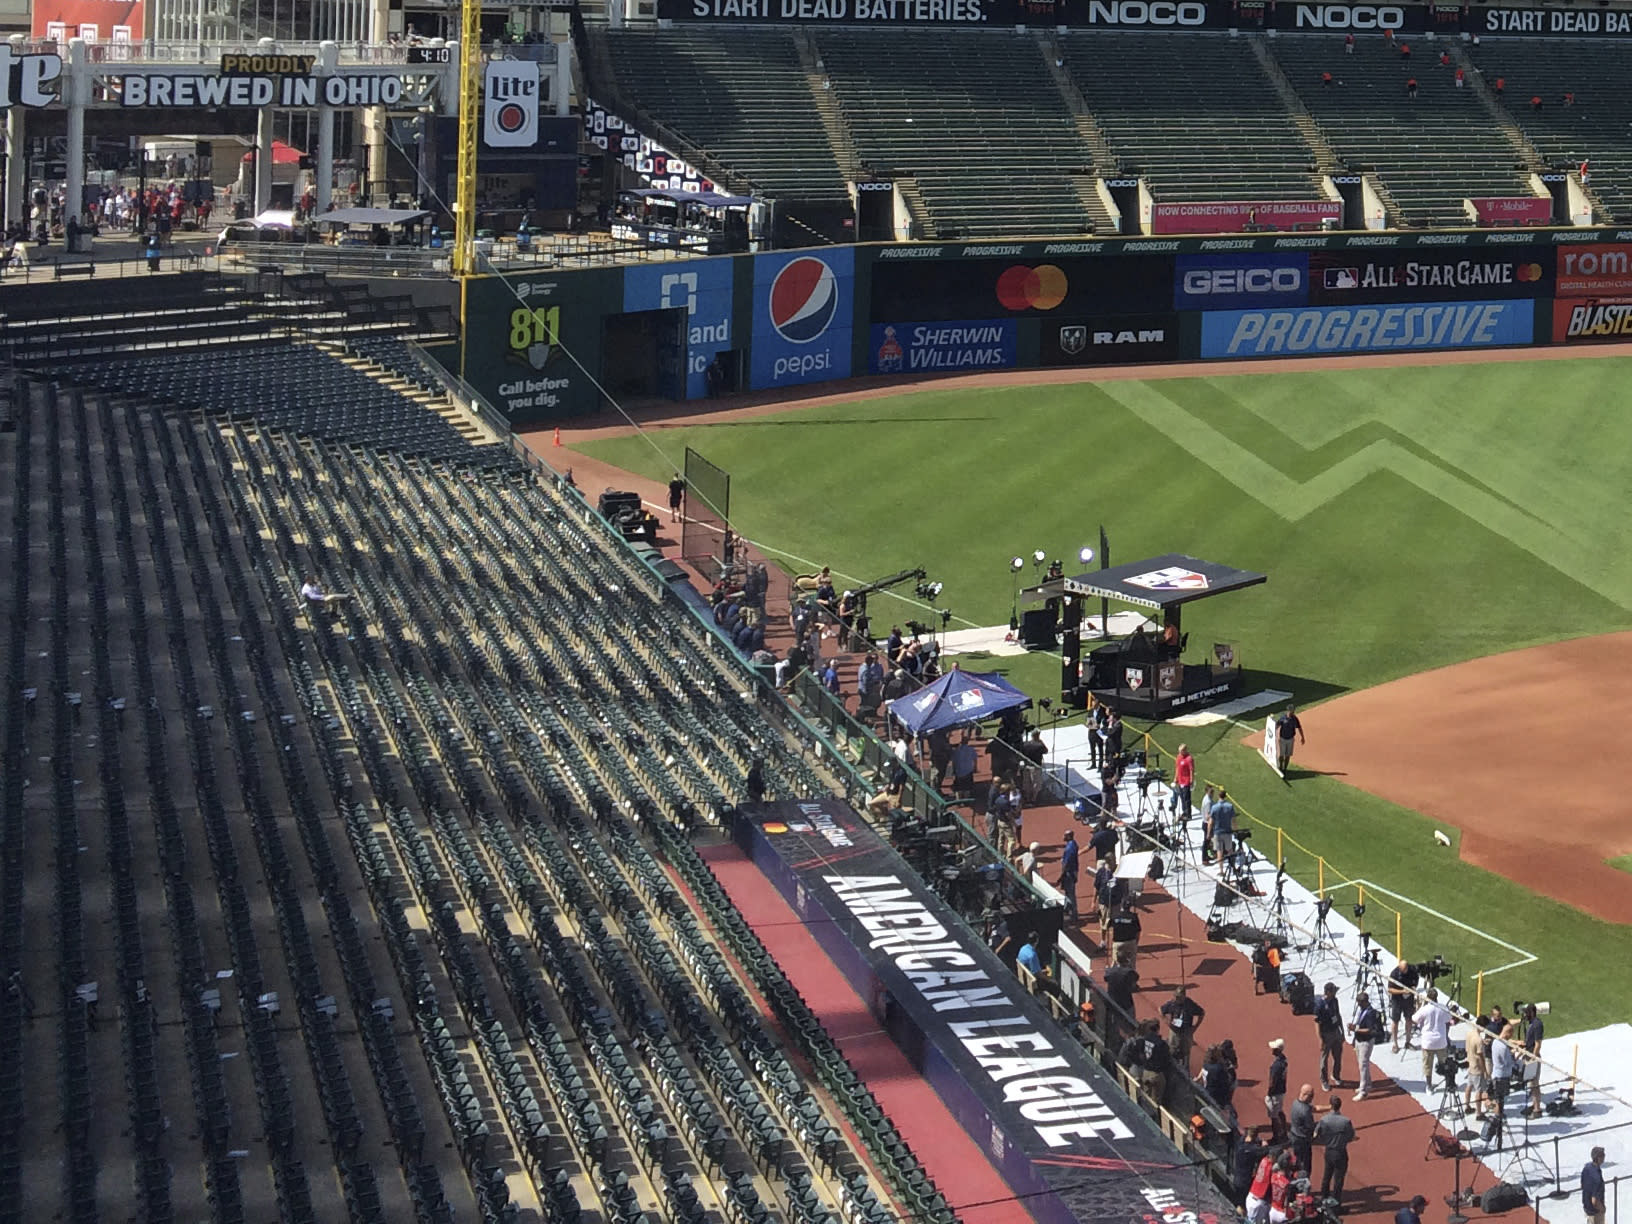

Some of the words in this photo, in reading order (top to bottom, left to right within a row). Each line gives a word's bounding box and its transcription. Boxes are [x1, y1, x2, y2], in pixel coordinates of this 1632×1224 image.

[1089, 0, 1206, 25] NOCO
[1296, 5, 1404, 29] NOCO
[1486, 10, 1545, 31] START
[1550, 12, 1600, 33] DEAD
[221, 55, 316, 73] PROUDLY
[420, 47, 450, 63] 4:10
[123, 76, 273, 107] BREWED
[282, 77, 316, 107] IN
[325, 75, 401, 105] OHIO
[490, 76, 536, 101] Lite
[857, 182, 893, 191] NOCO
[1106, 180, 1137, 188] NOCO
[1332, 176, 1361, 184] NOCO
[1158, 207, 1179, 216] NOW
[1318, 204, 1339, 213] FANS
[1183, 268, 1300, 294] GEICO
[1362, 263, 1398, 288] ALL
[510, 306, 560, 350] 811
[911, 326, 1003, 346] SHERWIN
[1093, 329, 1164, 345] RAM
[1227, 305, 1505, 353] PROGRESSIVE
[774, 349, 832, 379] pepsi
[909, 348, 1002, 368] WILLIAMS
[499, 380, 523, 396] Call
[526, 377, 569, 393] before
[508, 396, 532, 412] you
[535, 393, 560, 409] dig.
[1188, 683, 1229, 702] NETWORK
[822, 874, 1013, 1013] AMERICAN
[945, 1015, 1136, 1149] LEAGUE
